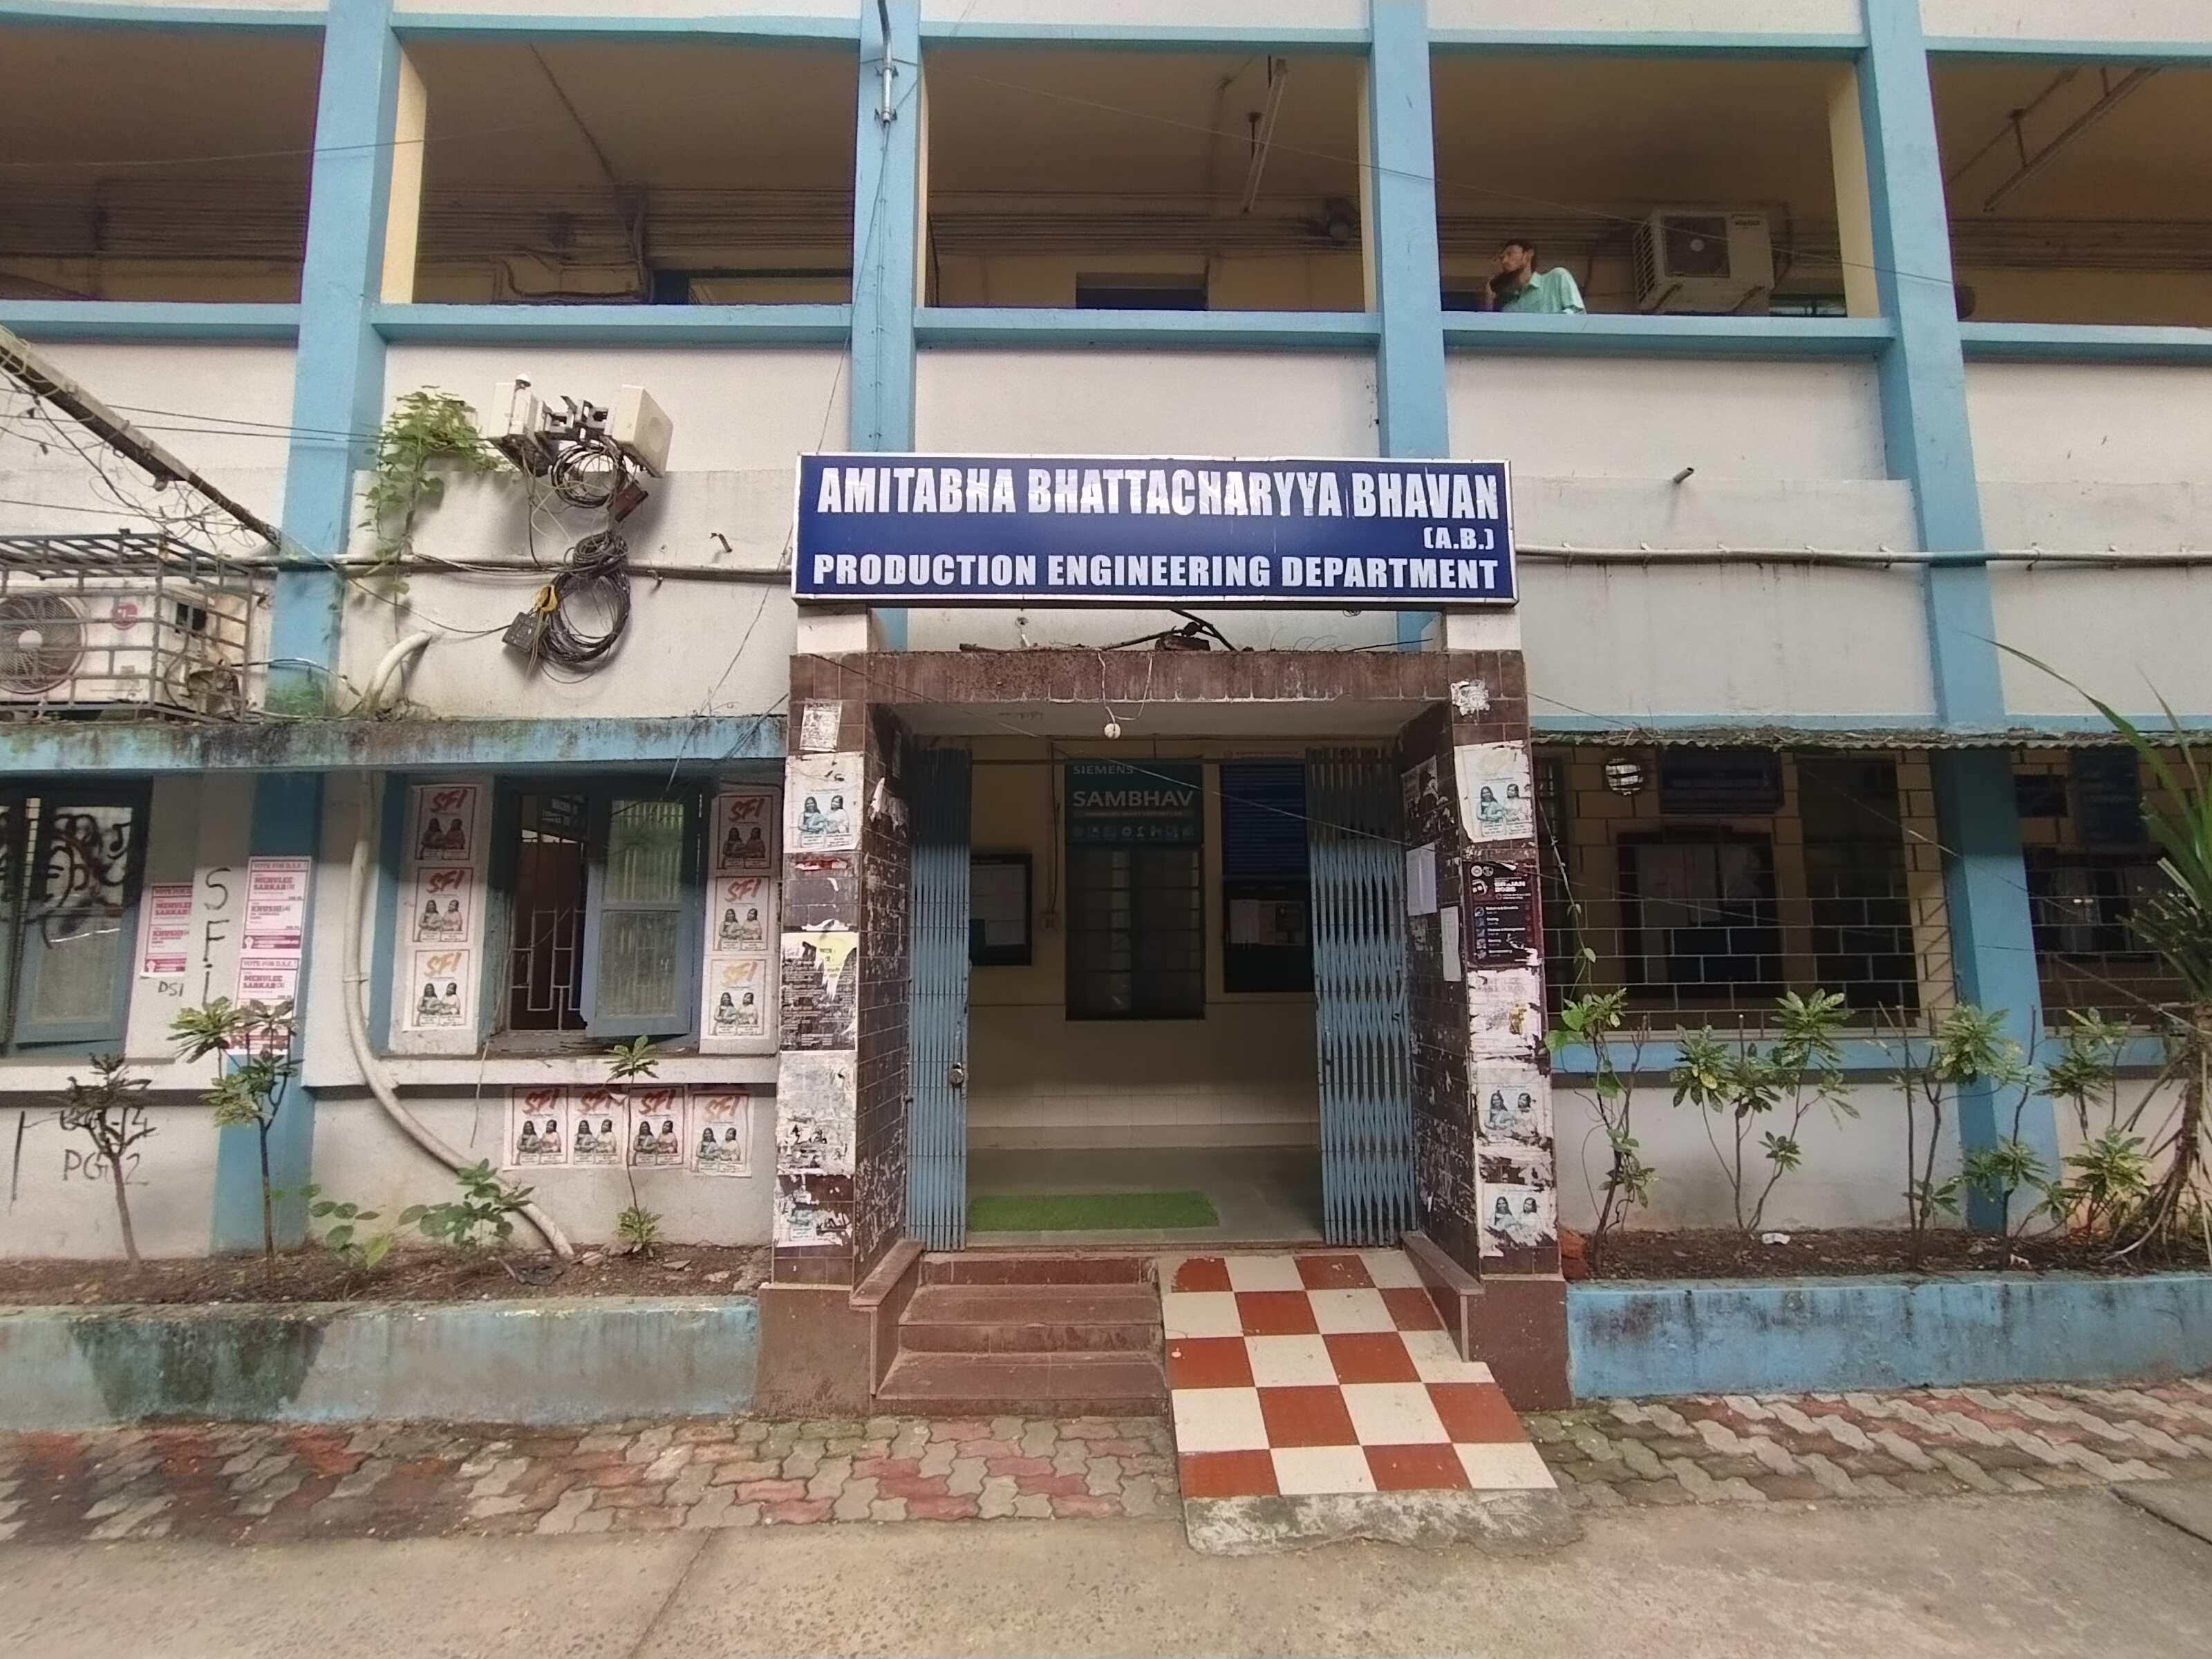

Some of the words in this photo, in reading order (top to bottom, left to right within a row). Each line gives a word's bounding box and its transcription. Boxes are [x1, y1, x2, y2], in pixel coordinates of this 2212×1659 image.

[817, 467, 1016, 513] AMITABHA
[1028, 469, 1342, 516] BHATTACHARYYA
[1352, 472, 1499, 520] BHAVAN
[1423, 527, 1494, 550] (A.B.)
[814, 554, 1036, 585] PRODUCTION
[1048, 555, 1271, 588] ENGINEERING
[1282, 556, 1499, 589] DEPARTMENT
[1073, 765, 1134, 775] SIEMENS
[430, 789, 468, 812] SFI
[729, 798, 765, 822] SFI
[1073, 790, 1194, 807] SAMBHAV
[426, 870, 465, 894] SFI
[724, 879, 762, 902] SFI
[424, 952, 462, 977] SFI
[523, 1088, 560, 1114] SFI
[638, 1089, 676, 1114] SFI
[702, 1096, 740, 1121] SFI
